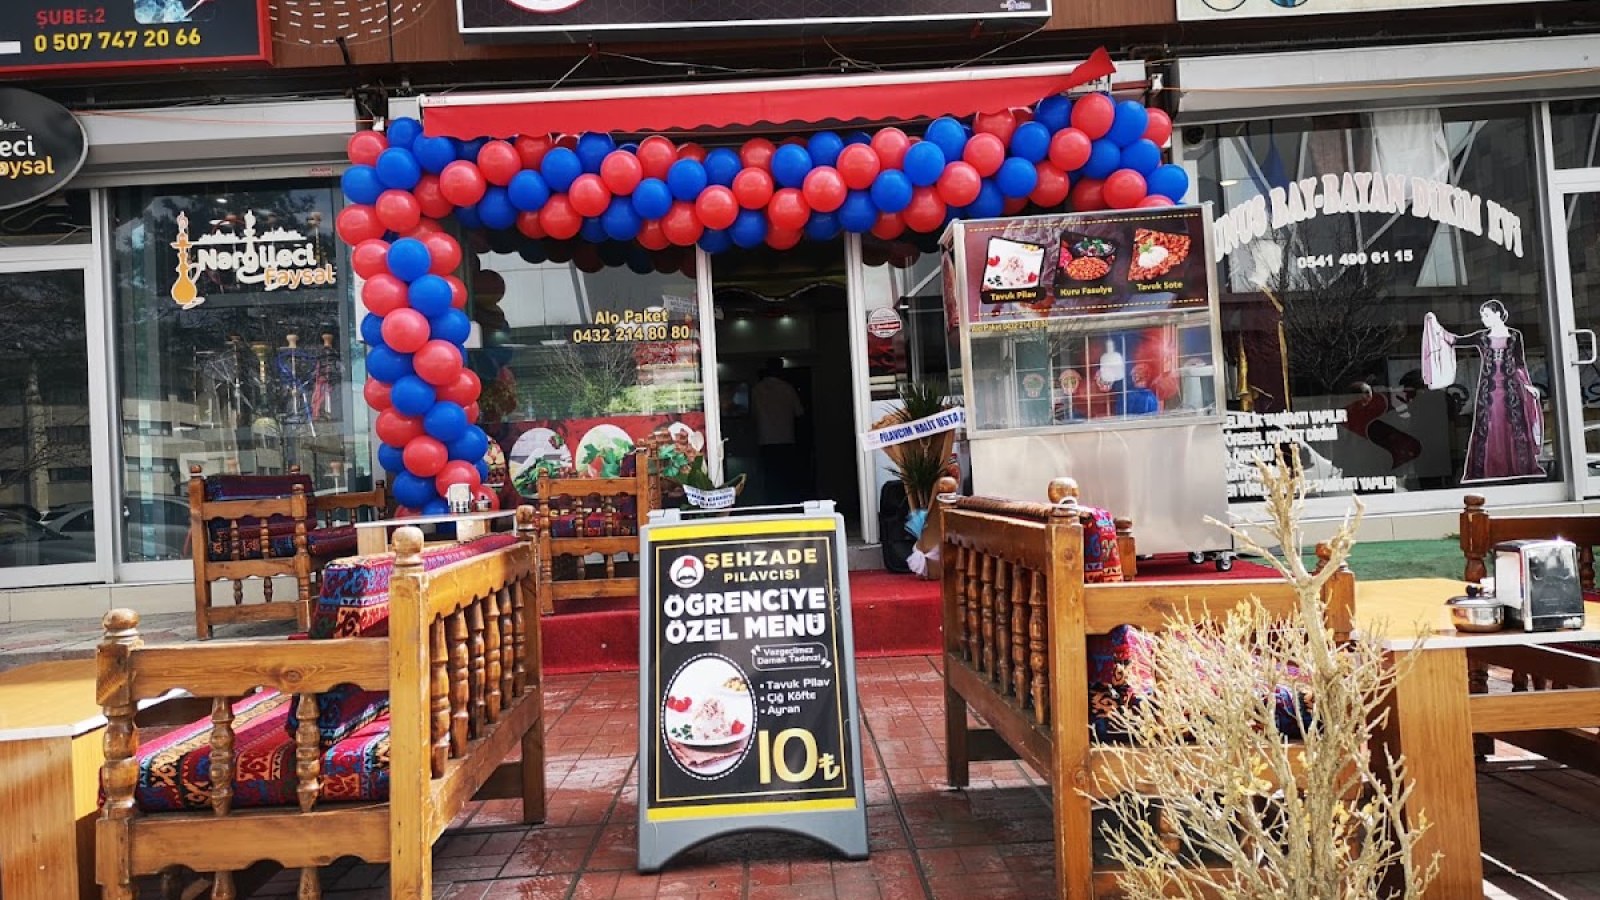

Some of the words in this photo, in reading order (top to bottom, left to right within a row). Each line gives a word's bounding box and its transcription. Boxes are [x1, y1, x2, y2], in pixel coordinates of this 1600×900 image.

[36, 8, 105, 29] ŞUBE:2
[34, 35, 47, 52] 0
[53, 32, 92, 51] 507
[98, 31, 138, 49] 747
[143, 30, 169, 47] 20
[175, 28, 201, 45] 66
[1297, 254, 1333, 269] 0541
[1339, 252, 1367, 266] 490
[1371, 250, 1390, 264] 61
[1394, 249, 1414, 262] 15
[264, 264, 336, 290] Faysal
[1060, 288, 1081, 297] Kuru
[1082, 286, 1113, 296] Fasulye
[1136, 282, 1162, 291] Tavuk
[1164, 281, 1184, 289] Sote
[990, 292, 1015, 302] Tavuk
[1016, 291, 1037, 300] Pilav
[595, 311, 620, 325] Alo
[624, 308, 668, 323] Paket
[572, 329, 610, 343] 0432
[615, 327, 644, 341] 214
[648, 326, 667, 340] 80
[671, 325, 690, 339] 80
[936, 412, 960, 428] USTA
[704, 548, 817, 570] ŞEHZADE
[723, 569, 800, 583] PILAVCISI
[664, 587, 826, 618] ÖĞRENCİYE
[665, 618, 738, 645] ÖZEL
[744, 613, 826, 640] MENÜ
[757, 656, 787, 665] Damak
[766, 680, 800, 690] Tavuk
[803, 678, 830, 688] Pilav
[767, 692, 784, 704] Çiğ
[788, 690, 816, 701] Köfte
[767, 706, 801, 717] Ayran
